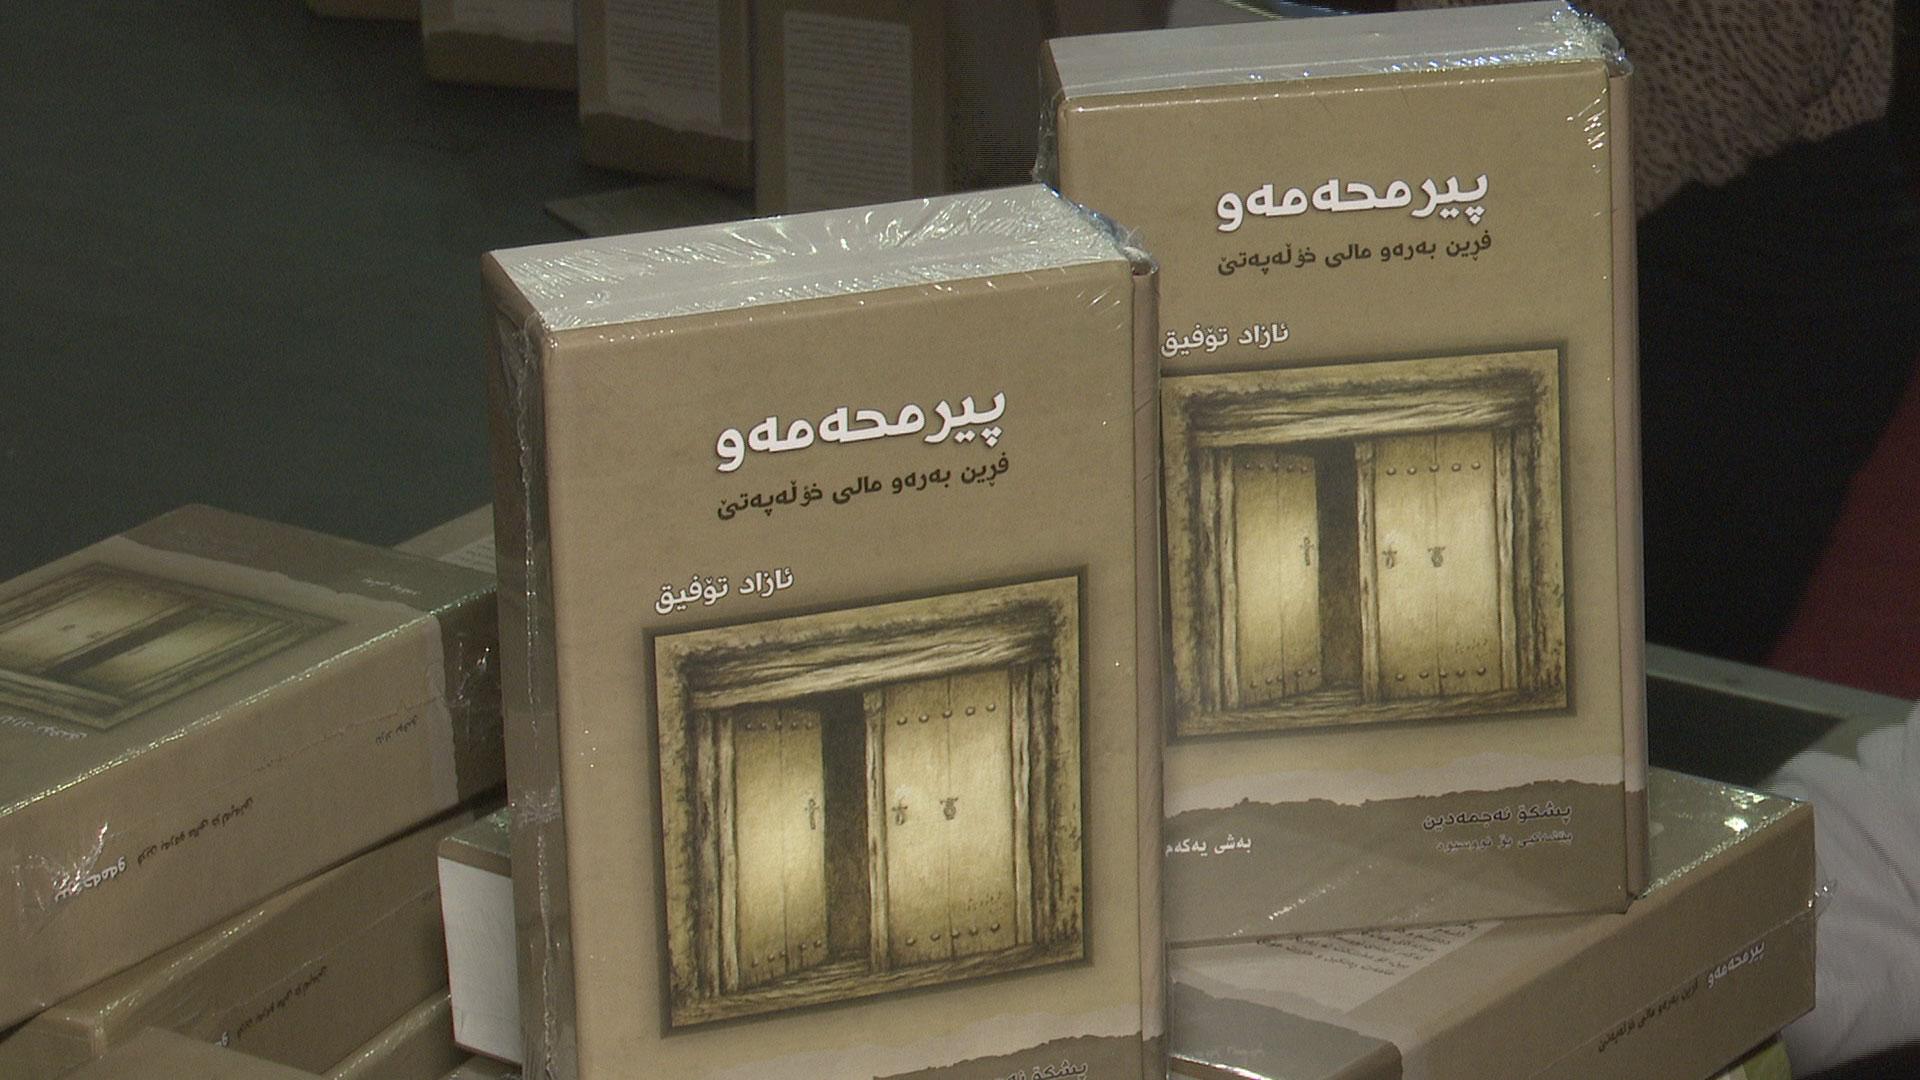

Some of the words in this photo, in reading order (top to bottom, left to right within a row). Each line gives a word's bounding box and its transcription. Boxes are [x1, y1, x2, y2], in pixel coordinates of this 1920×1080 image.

[1380, 240, 1436, 262] بەرەو
[1238, 323, 1289, 349] ئازاد
[891, 469, 951, 495] بەرەو
[739, 567, 794, 598] ئازاد
